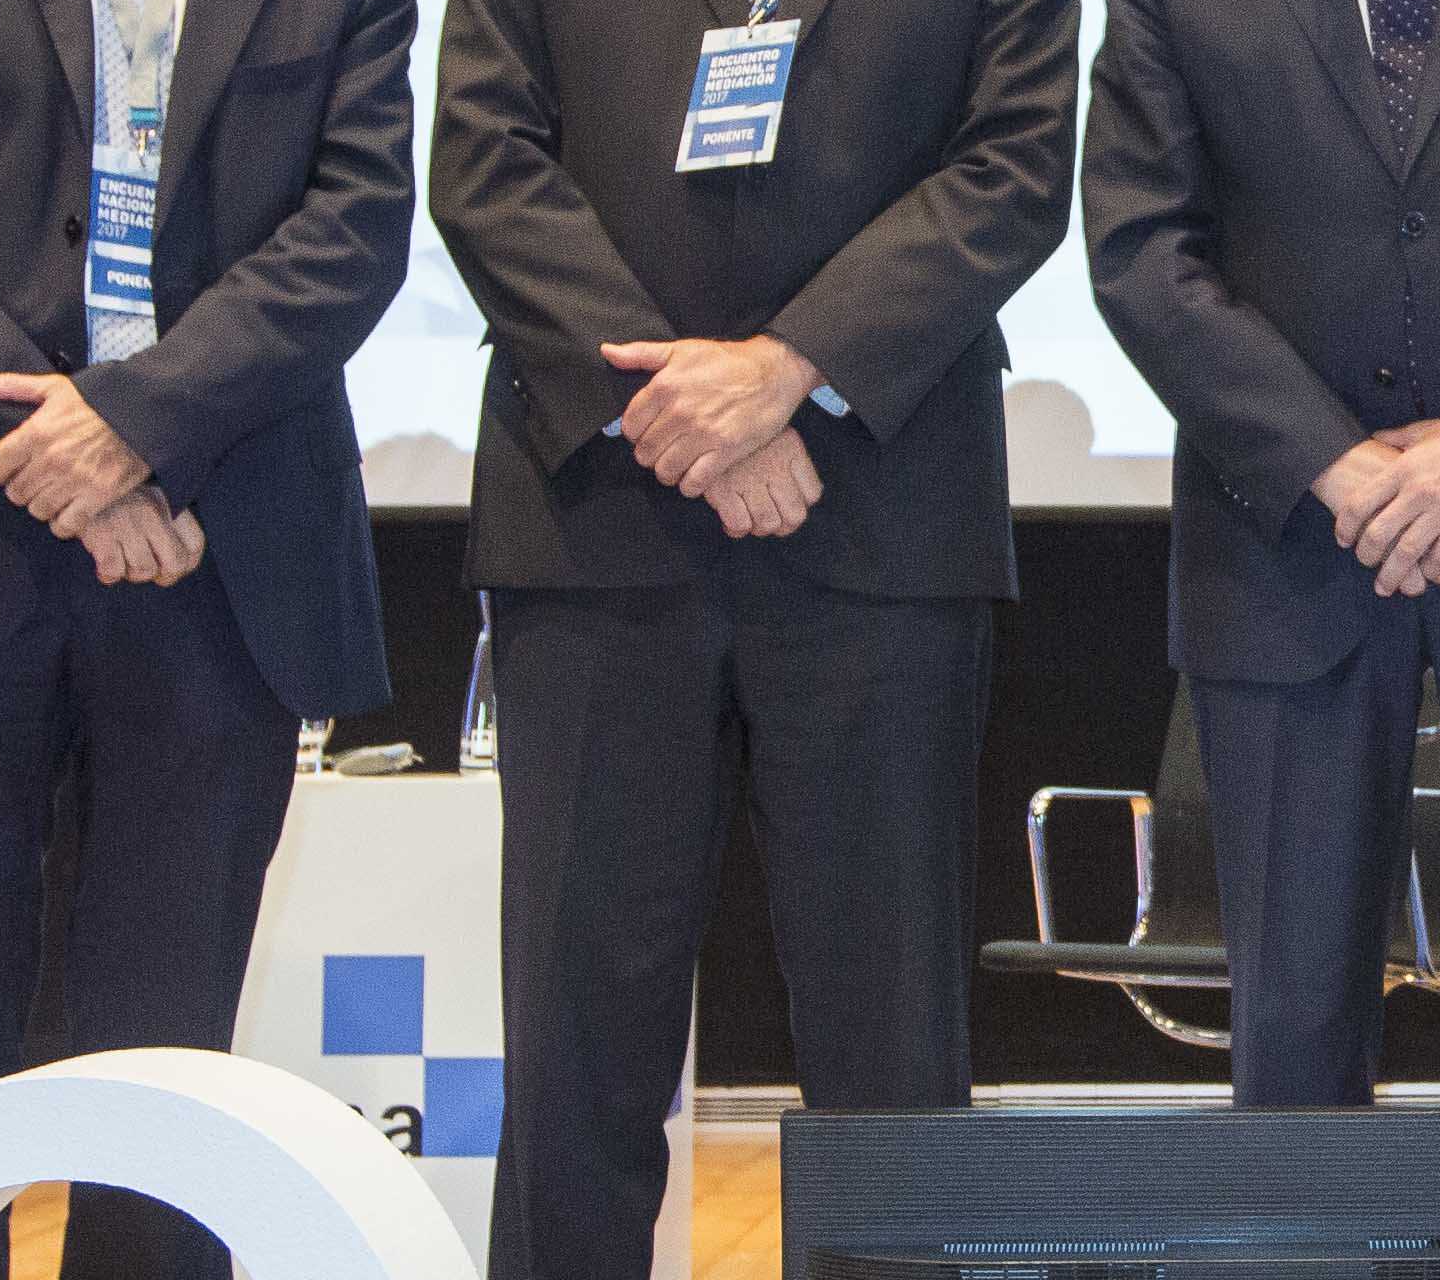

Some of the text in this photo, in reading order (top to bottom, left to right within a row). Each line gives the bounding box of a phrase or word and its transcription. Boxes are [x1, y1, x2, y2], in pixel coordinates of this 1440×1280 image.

[710, 48, 780, 68] ENCUENTRO
[702, 127, 755, 146] PONENTE
[99, 177, 156, 201] ENCUEN
